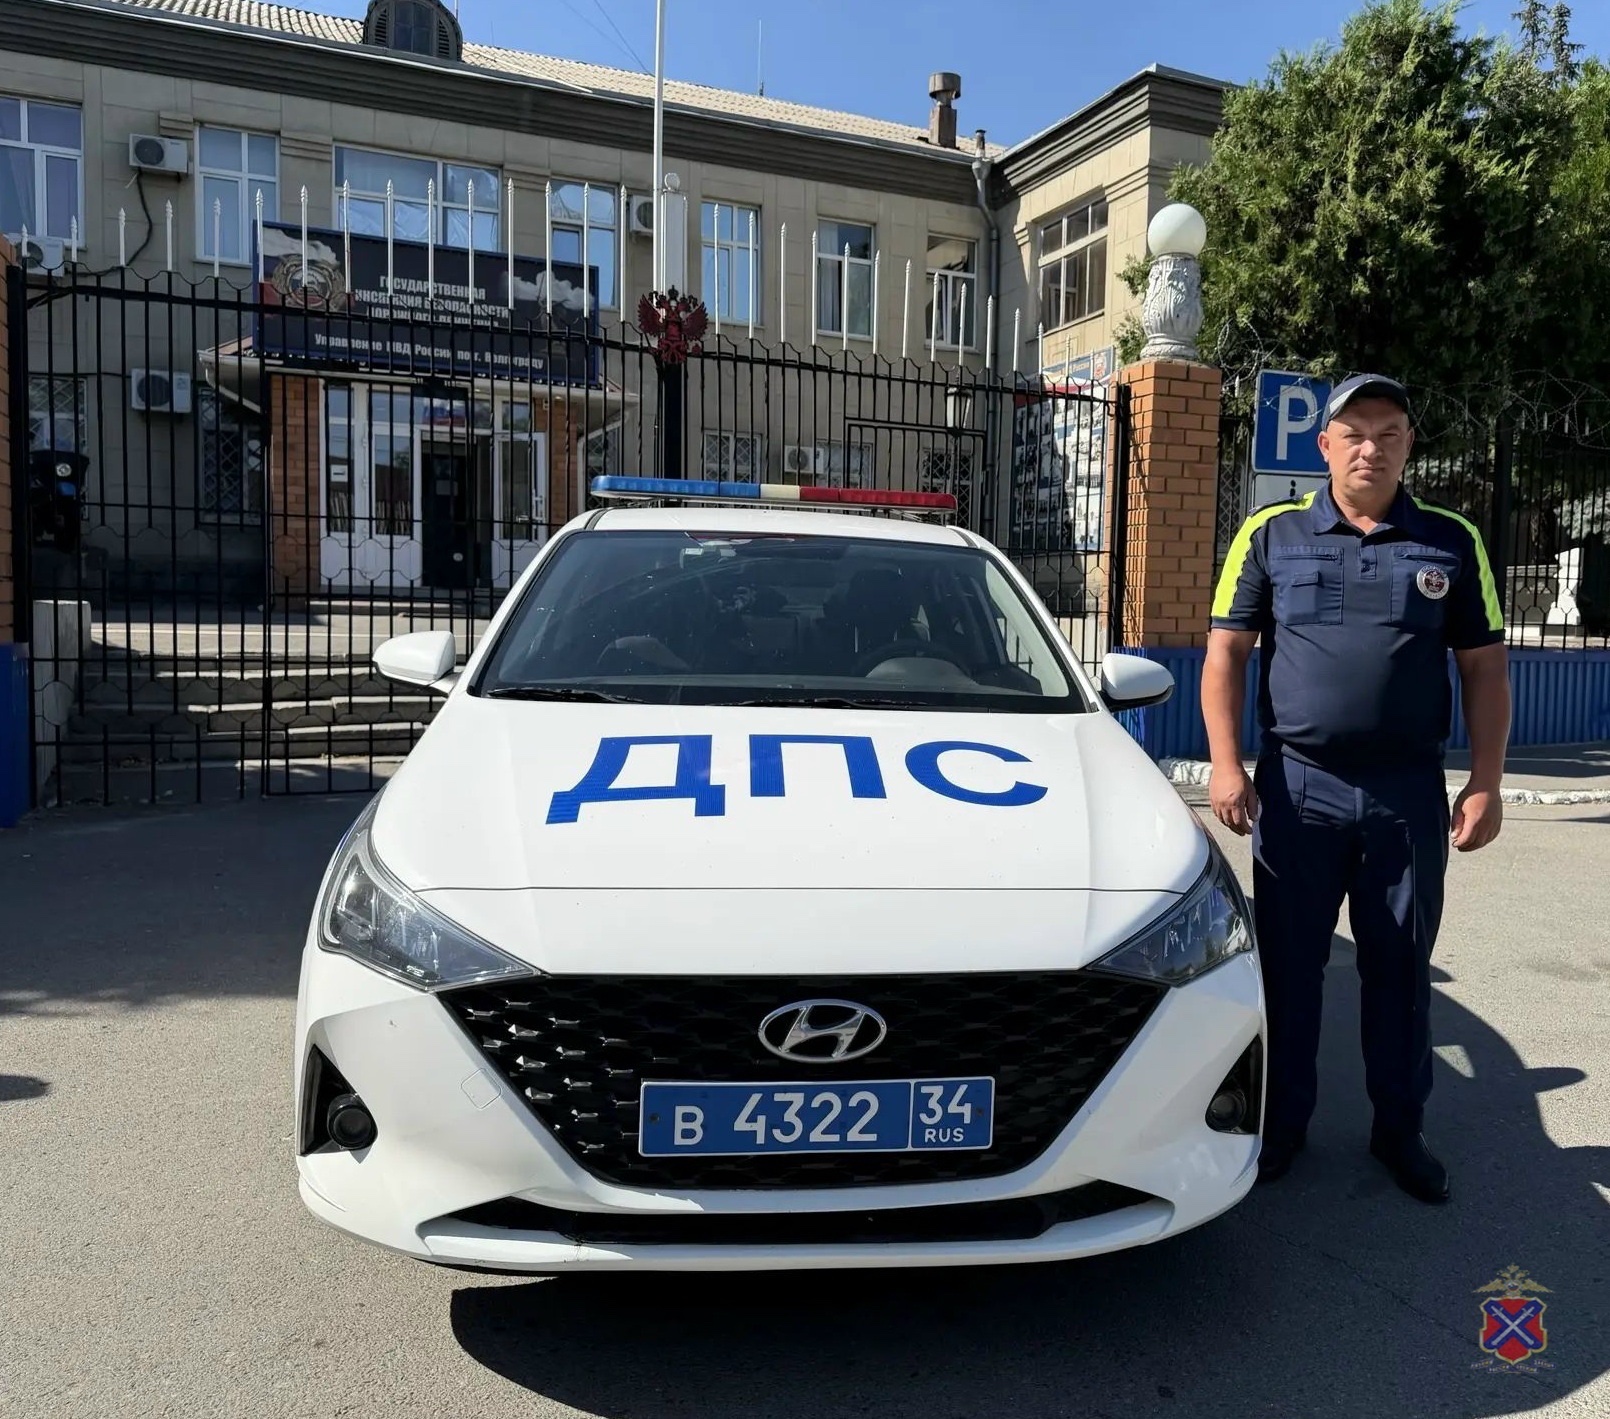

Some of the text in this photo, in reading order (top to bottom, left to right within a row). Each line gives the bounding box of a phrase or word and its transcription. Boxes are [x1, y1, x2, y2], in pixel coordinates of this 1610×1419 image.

[379, 275, 486, 300] ГСУДАРСТВЕННАЯ
[457, 350, 471, 361] по
[1276, 385, 1318, 461] P
[545, 733, 1049, 824] ДПС
[733, 1090, 880, 1144] 4322
[919, 1084, 972, 1125] 34
[925, 1128, 965, 1143] RUS
